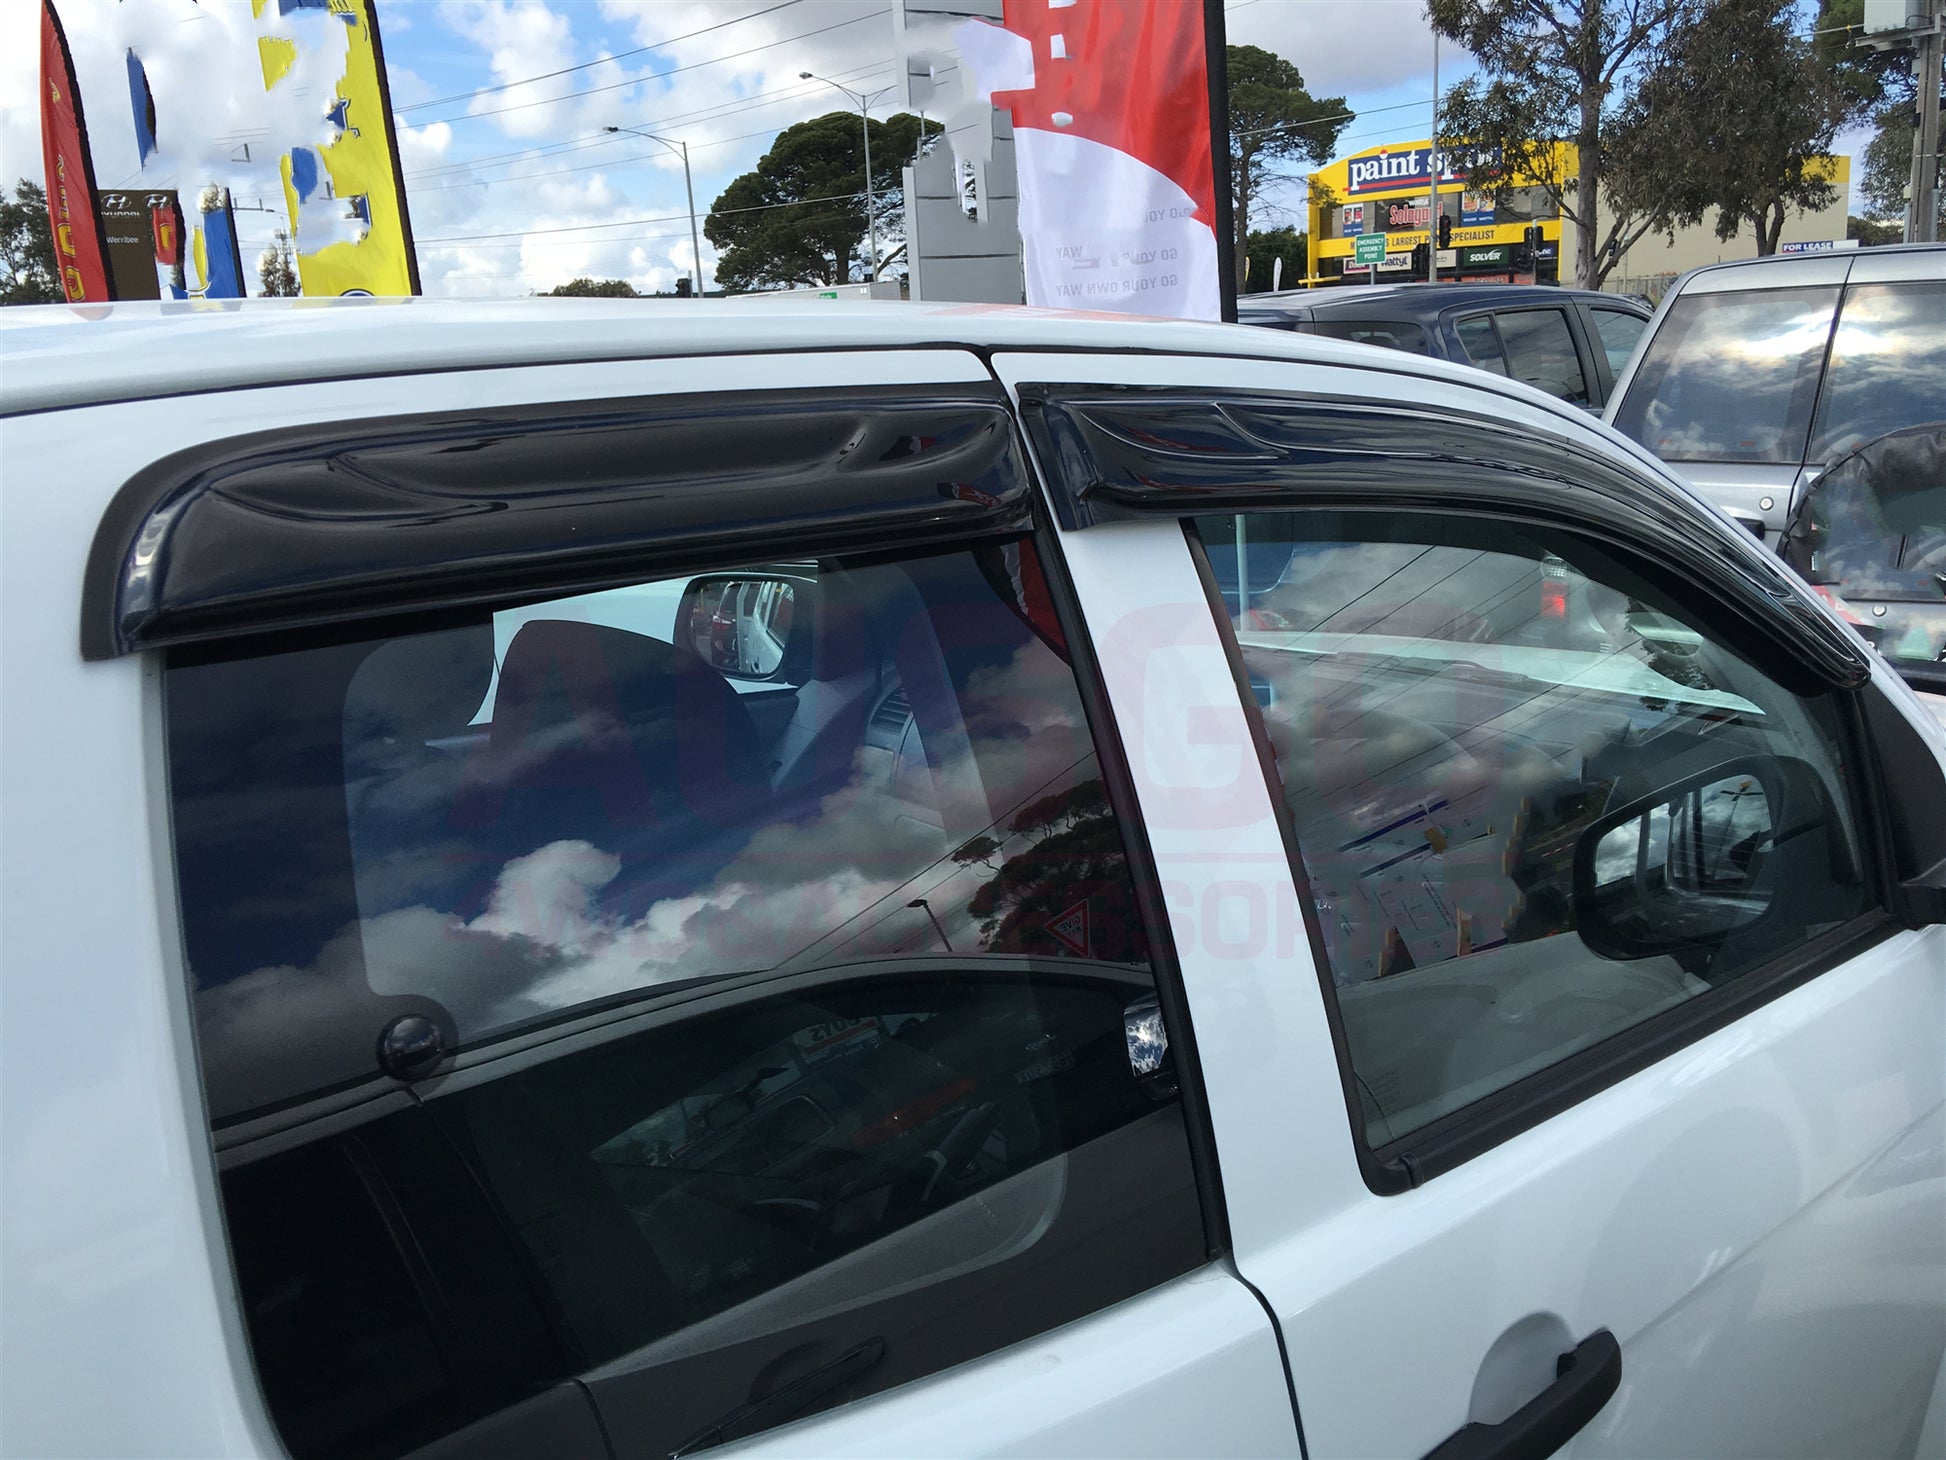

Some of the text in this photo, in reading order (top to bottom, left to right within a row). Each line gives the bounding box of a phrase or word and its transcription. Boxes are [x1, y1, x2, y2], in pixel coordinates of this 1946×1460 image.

[1350, 149, 1420, 191] paint
[1391, 235, 1421, 247] LARGEST
[1783, 241, 1832, 251] FOR LEASE
[1363, 252, 1378, 260] POINT
[1469, 249, 1502, 262] SOLVER
